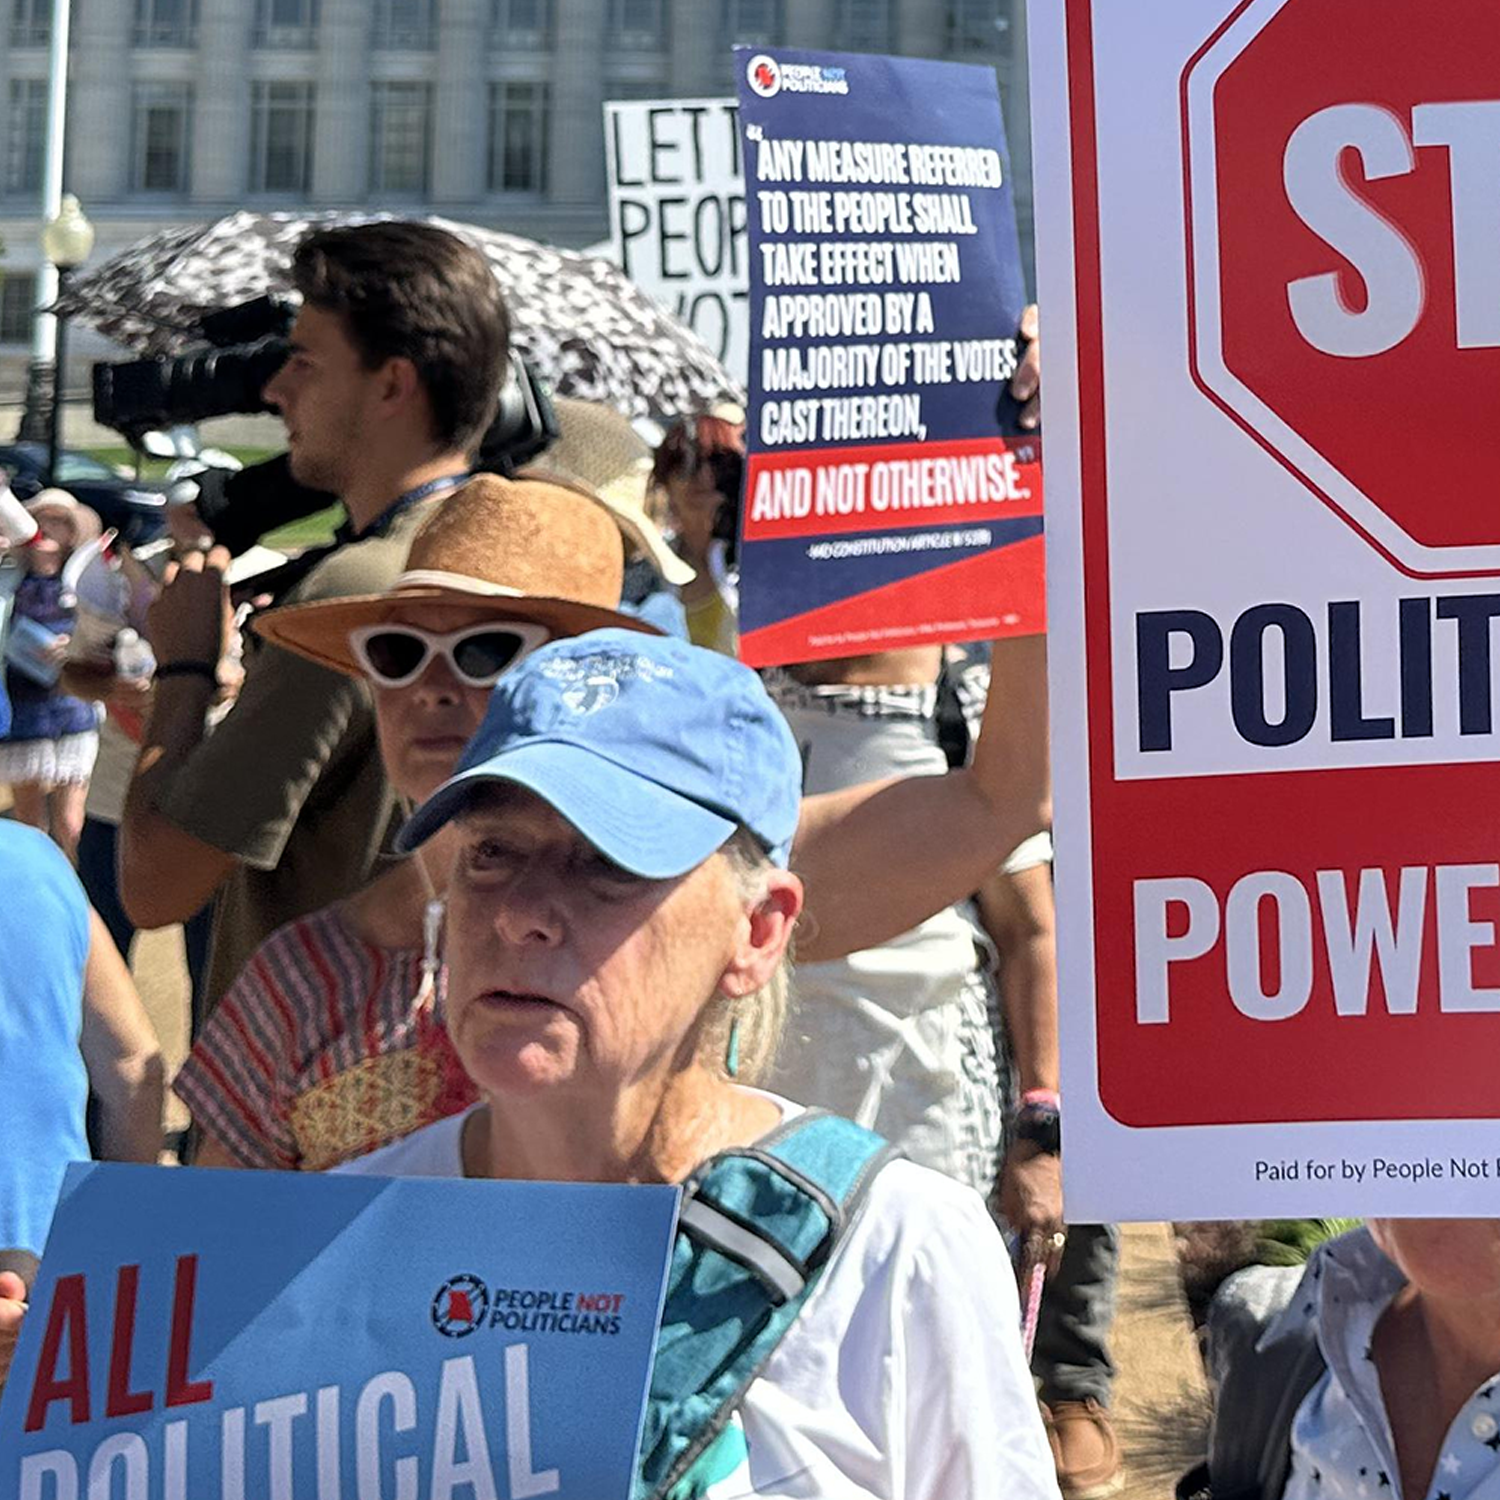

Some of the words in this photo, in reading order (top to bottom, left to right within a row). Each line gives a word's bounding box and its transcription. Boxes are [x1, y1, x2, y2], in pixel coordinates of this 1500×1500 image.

[612, 107, 708, 186] LET
[805, 141, 909, 184] MEASURE
[908, 145, 1002, 189] REFERRED
[758, 191, 789, 233] TO
[789, 191, 833, 233] THE
[833, 192, 913, 233] PEOPLE
[913, 193, 978, 234] SHALL
[620, 195, 747, 280] PEOP
[759, 243, 818, 286] TAKE
[820, 243, 895, 285] EFFECT
[896, 242, 961, 284] WHEN
[762, 293, 883, 338] APPROVED
[884, 292, 915, 335] BY
[916, 291, 934, 334] A
[763, 345, 880, 392] MAJORITY
[881, 343, 911, 387] OF
[911, 342, 952, 385] THE
[953, 339, 1017, 382] VOTES
[761, 399, 821, 445] CAST
[821, 394, 928, 442] THEREON,
[751, 464, 813, 522] AND
[815, 462, 869, 516] NOT
[1255, 1160, 1299, 1181] Paid
[1306, 1159, 1334, 1180] for
[1341, 1159, 1365, 1183] by
[1373, 1158, 1443, 1183] People
[1450, 1158, 1489, 1178] Not
[489, 1310, 622, 1335] POLITICIANS
[491, 1288, 573, 1312] PEOPLE
[576, 1292, 625, 1314] NOT
[25, 1254, 214, 1434] ALL
